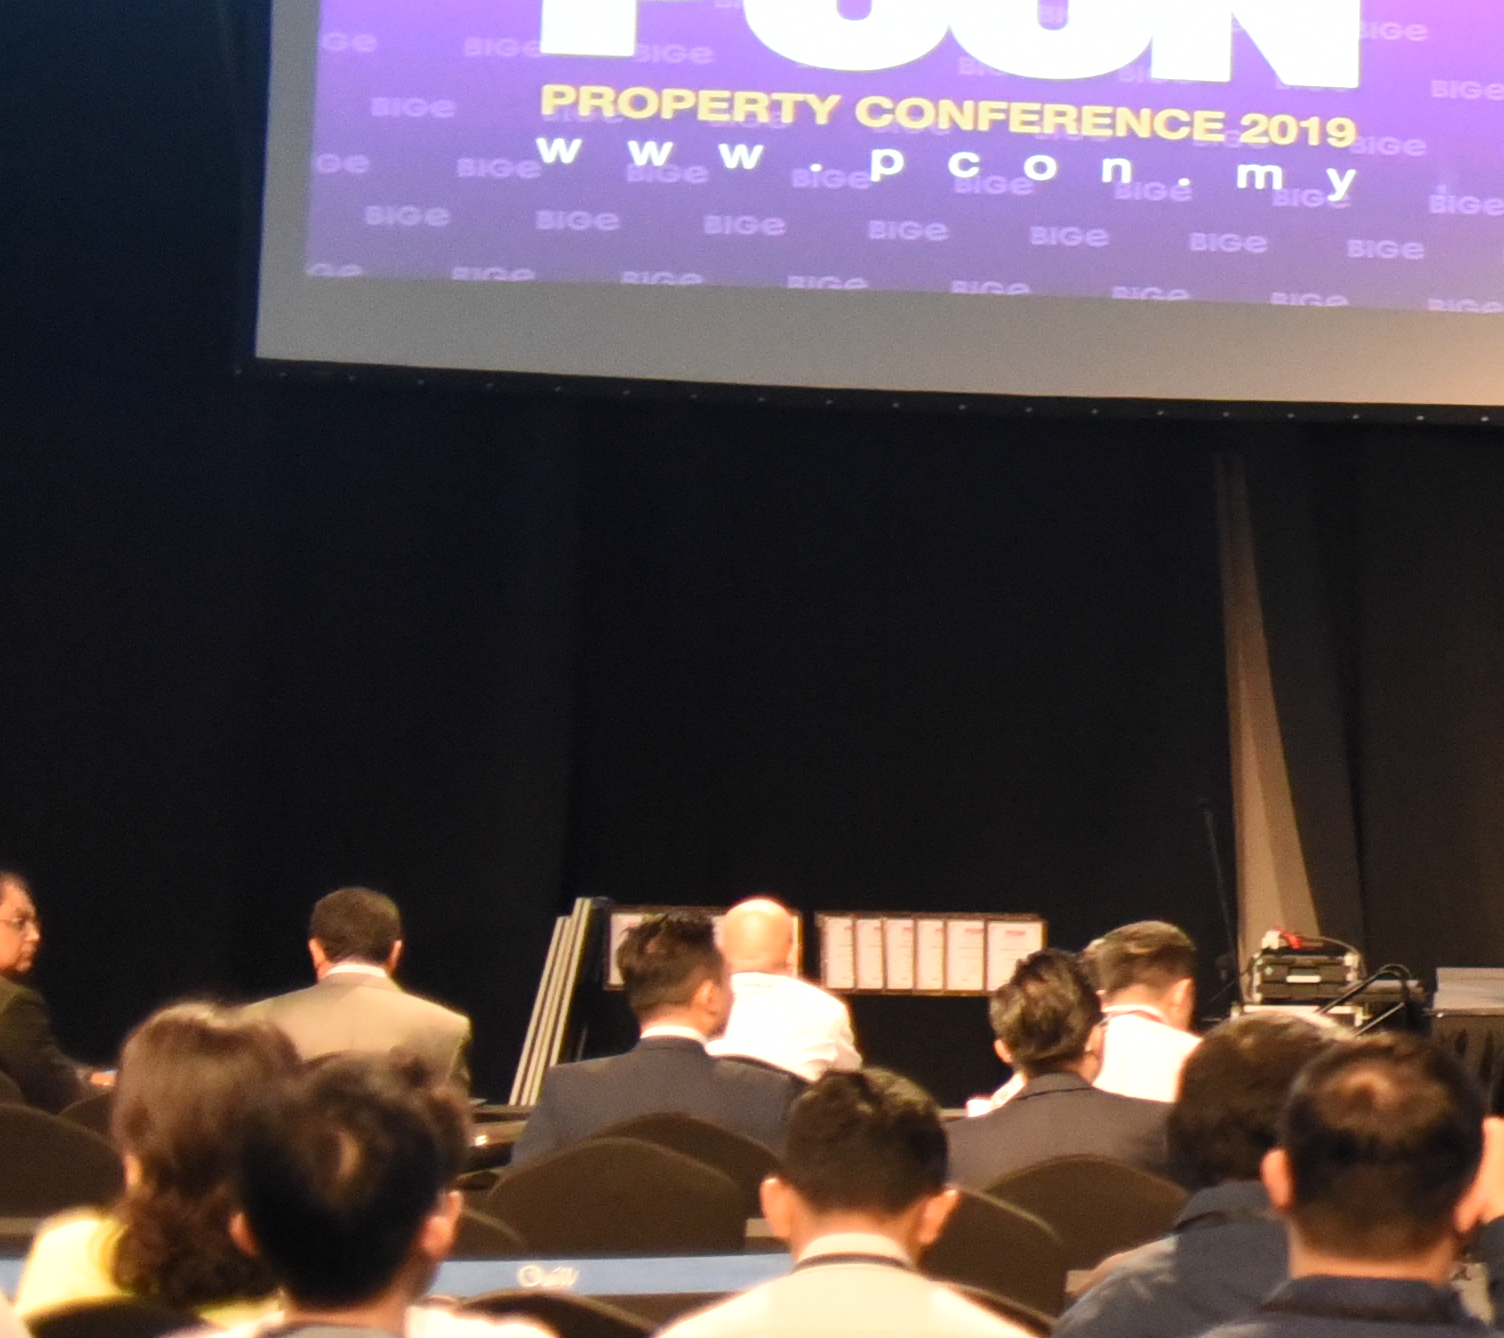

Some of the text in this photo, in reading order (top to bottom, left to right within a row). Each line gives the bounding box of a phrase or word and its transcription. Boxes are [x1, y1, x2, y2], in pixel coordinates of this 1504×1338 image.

[541, 83, 1357, 148] PROPERTY CONFERENCE 2019
